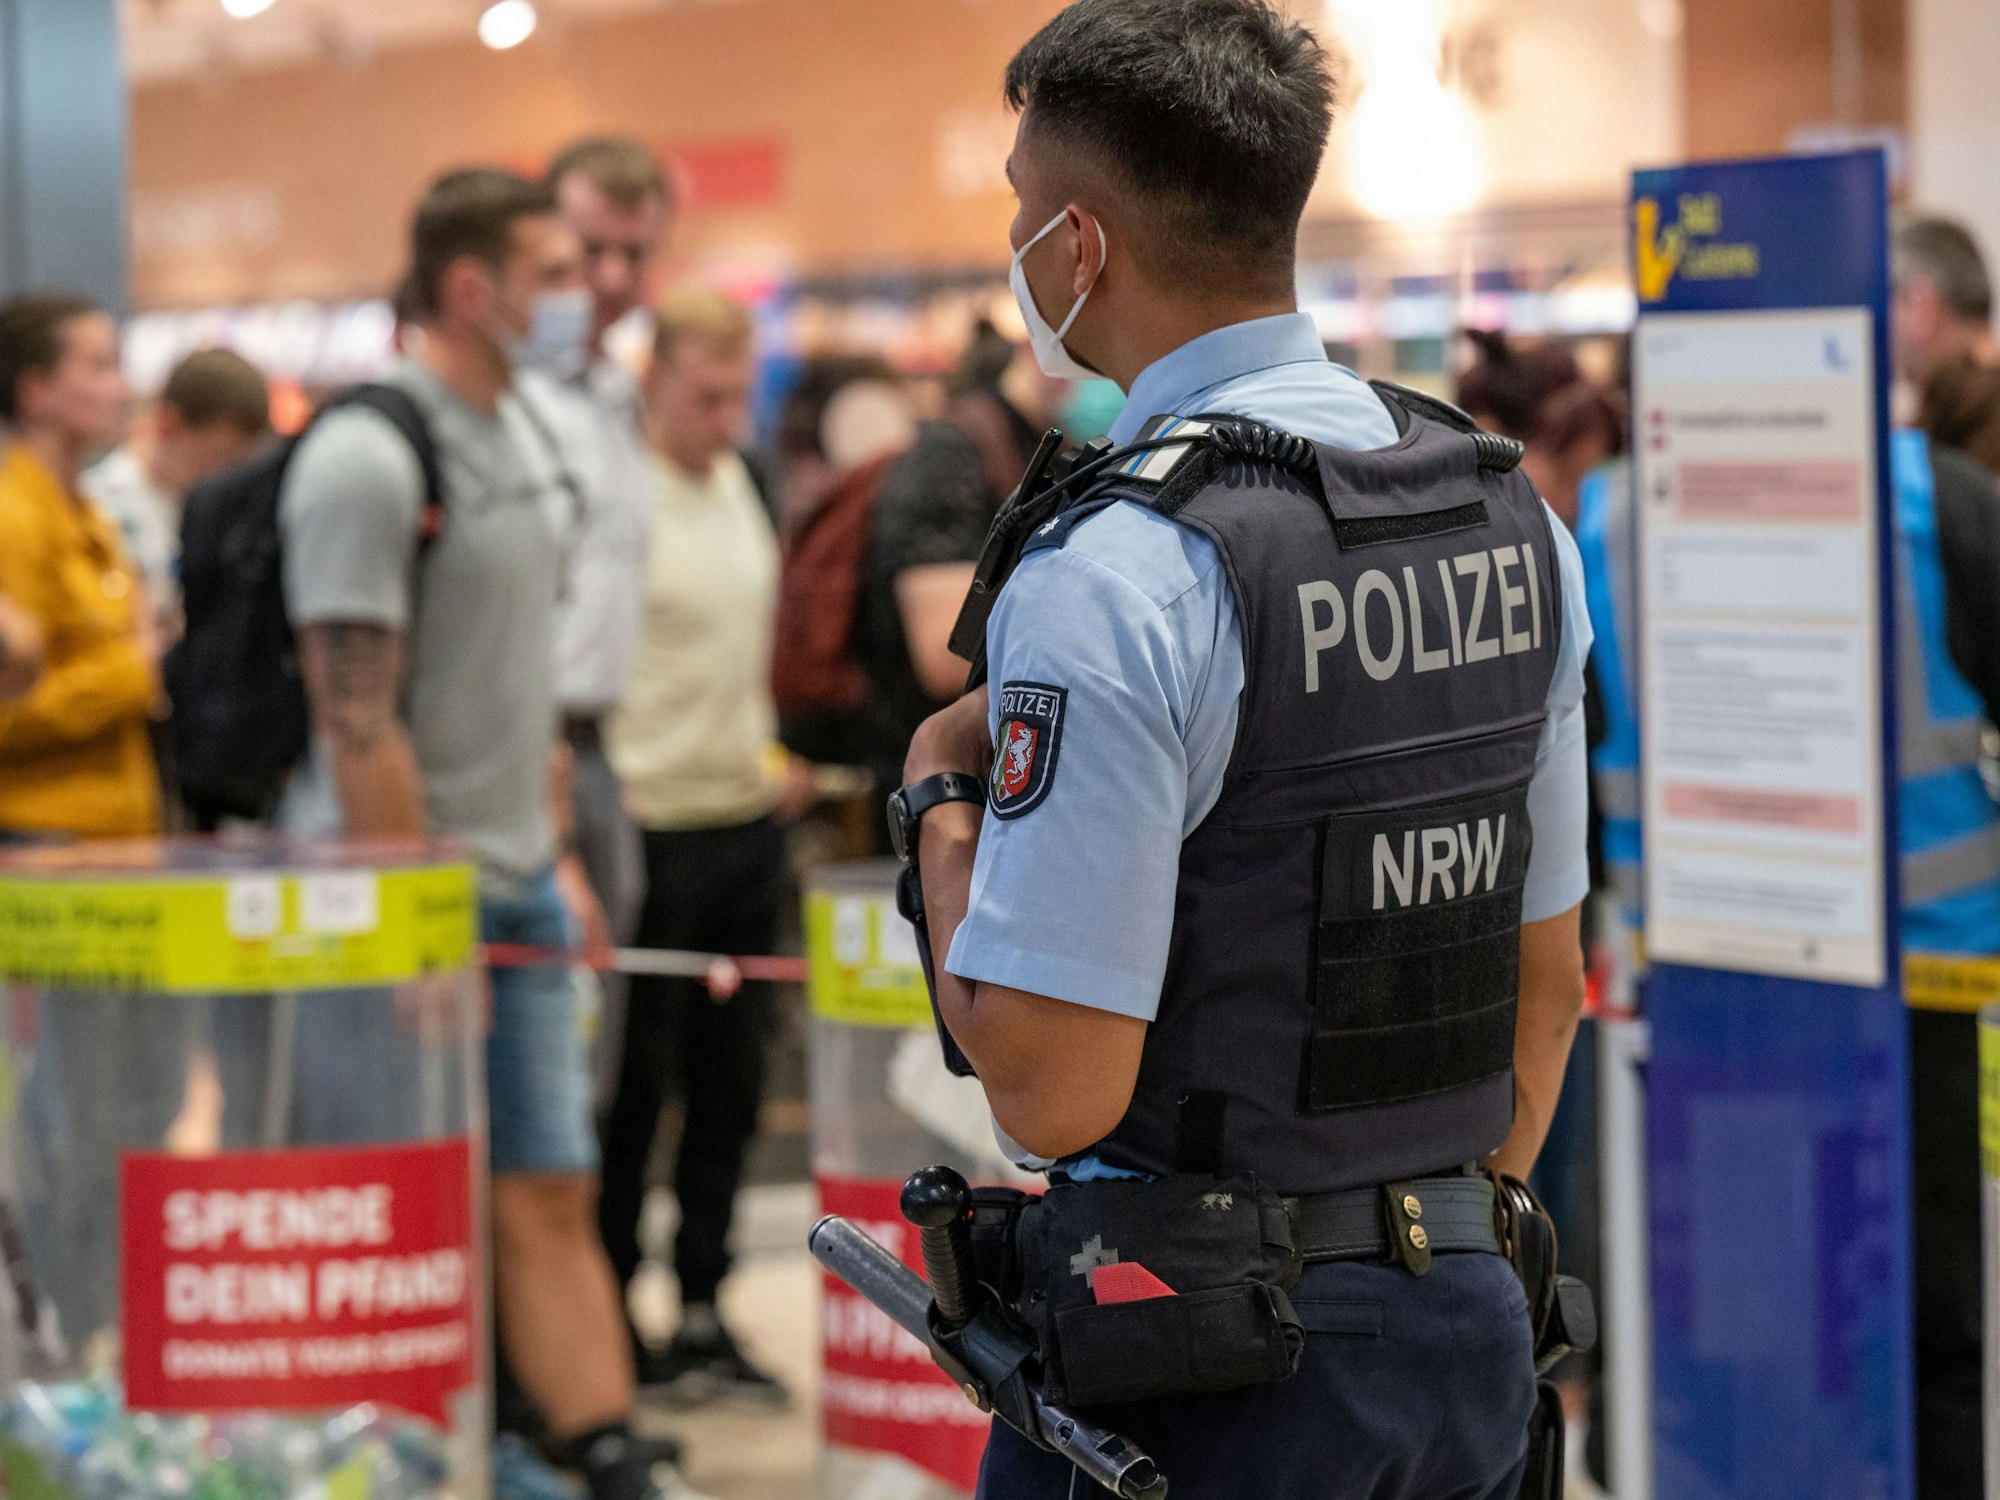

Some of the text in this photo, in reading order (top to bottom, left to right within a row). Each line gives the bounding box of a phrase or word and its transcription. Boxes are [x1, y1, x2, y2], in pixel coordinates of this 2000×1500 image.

[1297, 543, 1542, 693] POLIZEI
[1001, 693, 1056, 718] POLIZEI
[1372, 814, 1507, 910] NRW
[164, 1184, 394, 1250] SPENDE
[165, 1248, 466, 1324] DEIN PFAND
